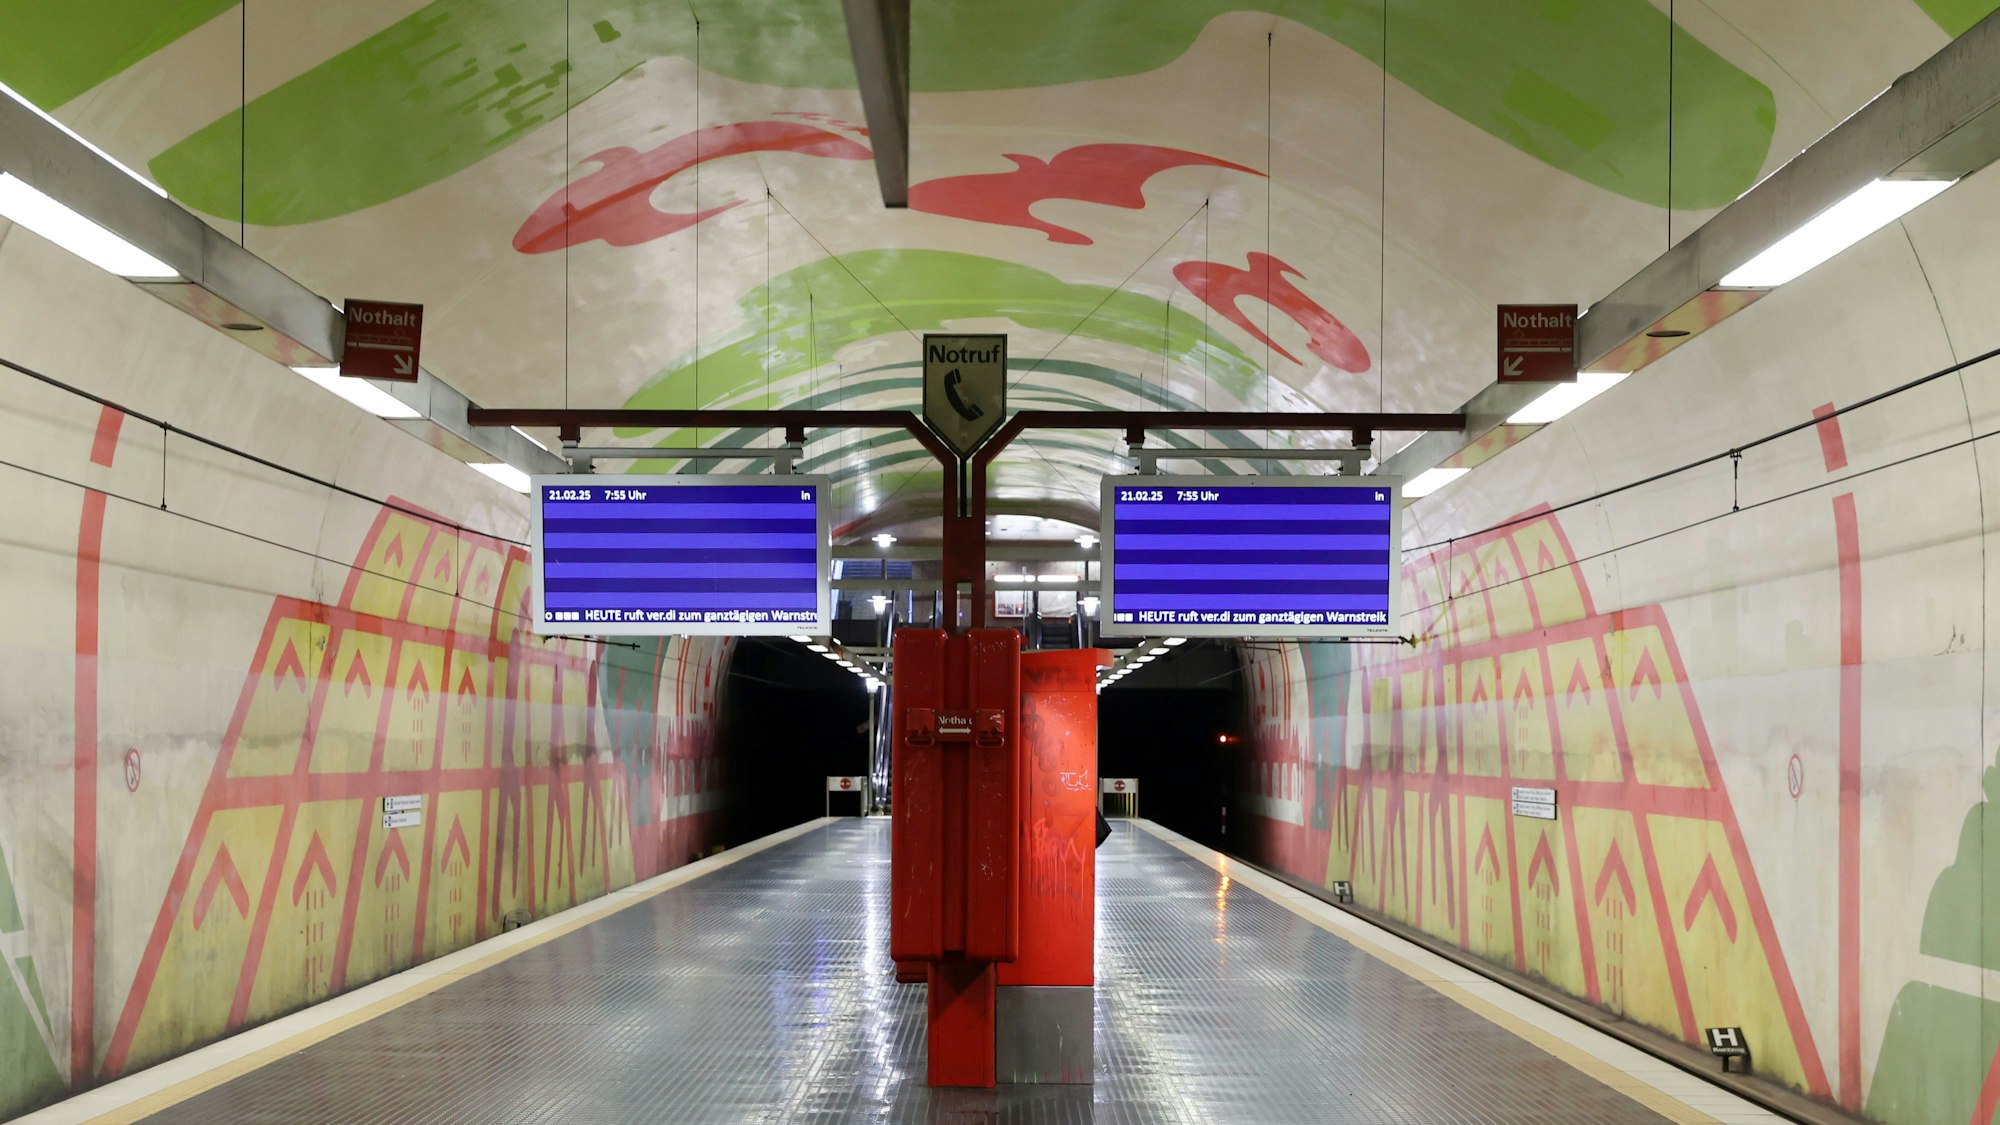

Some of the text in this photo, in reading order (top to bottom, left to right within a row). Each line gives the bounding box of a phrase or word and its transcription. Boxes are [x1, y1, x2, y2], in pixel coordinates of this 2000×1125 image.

[348, 306, 417, 328] Nothalt
[1503, 312, 1573, 328] Nothalt
[929, 344, 1000, 363] Notruf
[548, 489, 592, 501] 21.02.25
[604, 489, 627, 501] 7:55
[628, 489, 647, 501] Uhr
[1120, 491, 1164, 502] 21.02.25
[1176, 491, 1199, 502] 7:55
[1200, 491, 1220, 502] Uhr
[584, 609, 622, 621] HEUTE
[624, 609, 645, 621] ruft
[646, 609, 676, 621] ver.di
[679, 611, 702, 621] zum
[704, 609, 769, 623] ganztägigen
[1139, 610, 1387, 624] HEUTE ruft ver.di zum ganztägigen Warnstreik
[1334, 882, 1350, 895] H
[1711, 1028, 1738, 1047] H
